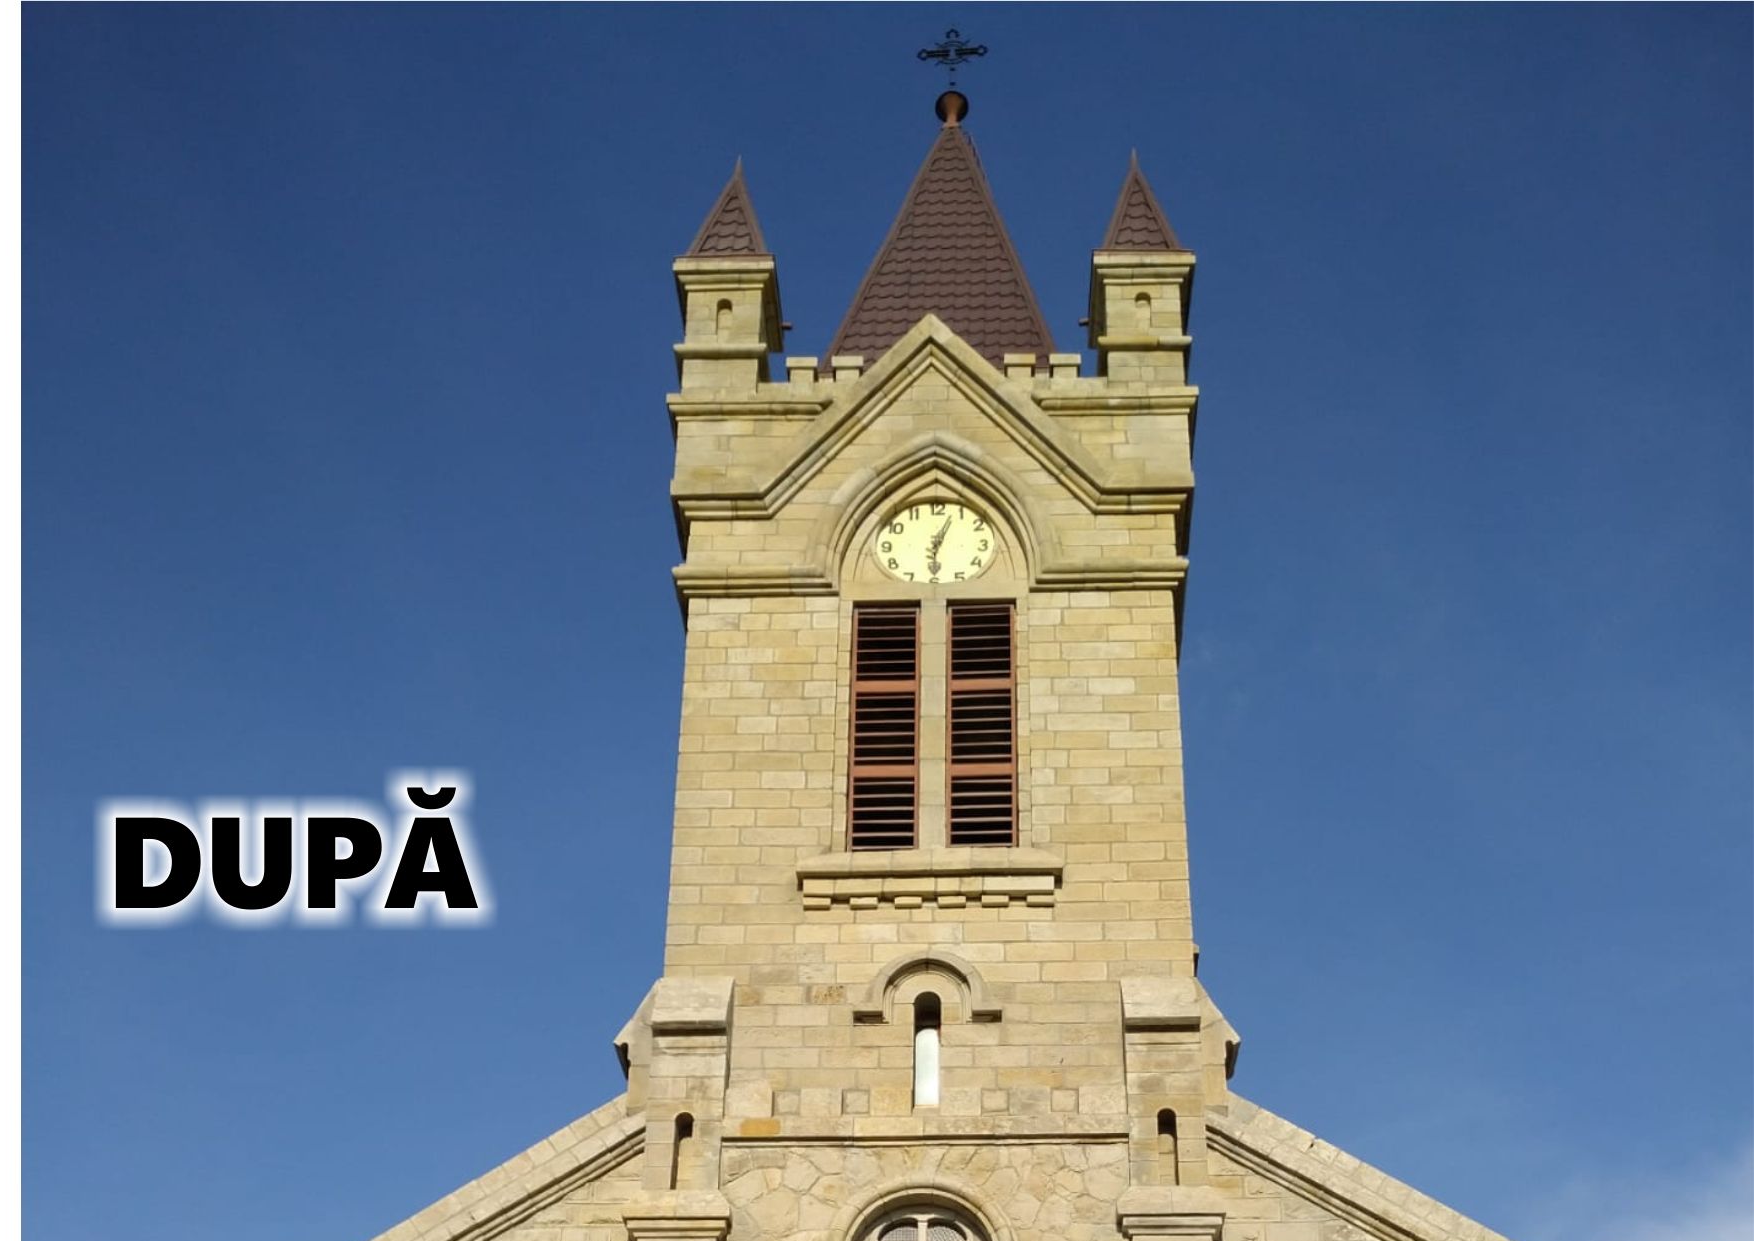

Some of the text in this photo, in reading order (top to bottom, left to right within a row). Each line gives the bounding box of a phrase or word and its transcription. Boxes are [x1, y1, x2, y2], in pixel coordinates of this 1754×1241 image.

[908, 506, 920, 521] 11
[930, 502, 946, 516] 12
[958, 506, 964, 521] 1
[888, 521, 904, 535] 10
[972, 518, 985, 532] 2
[881, 541, 893, 553] 9
[977, 539, 989, 552] 3
[888, 557, 899, 570] 8
[970, 556, 982, 568] 4
[903, 572, 914, 582] 7
[954, 572, 965, 582] 5
